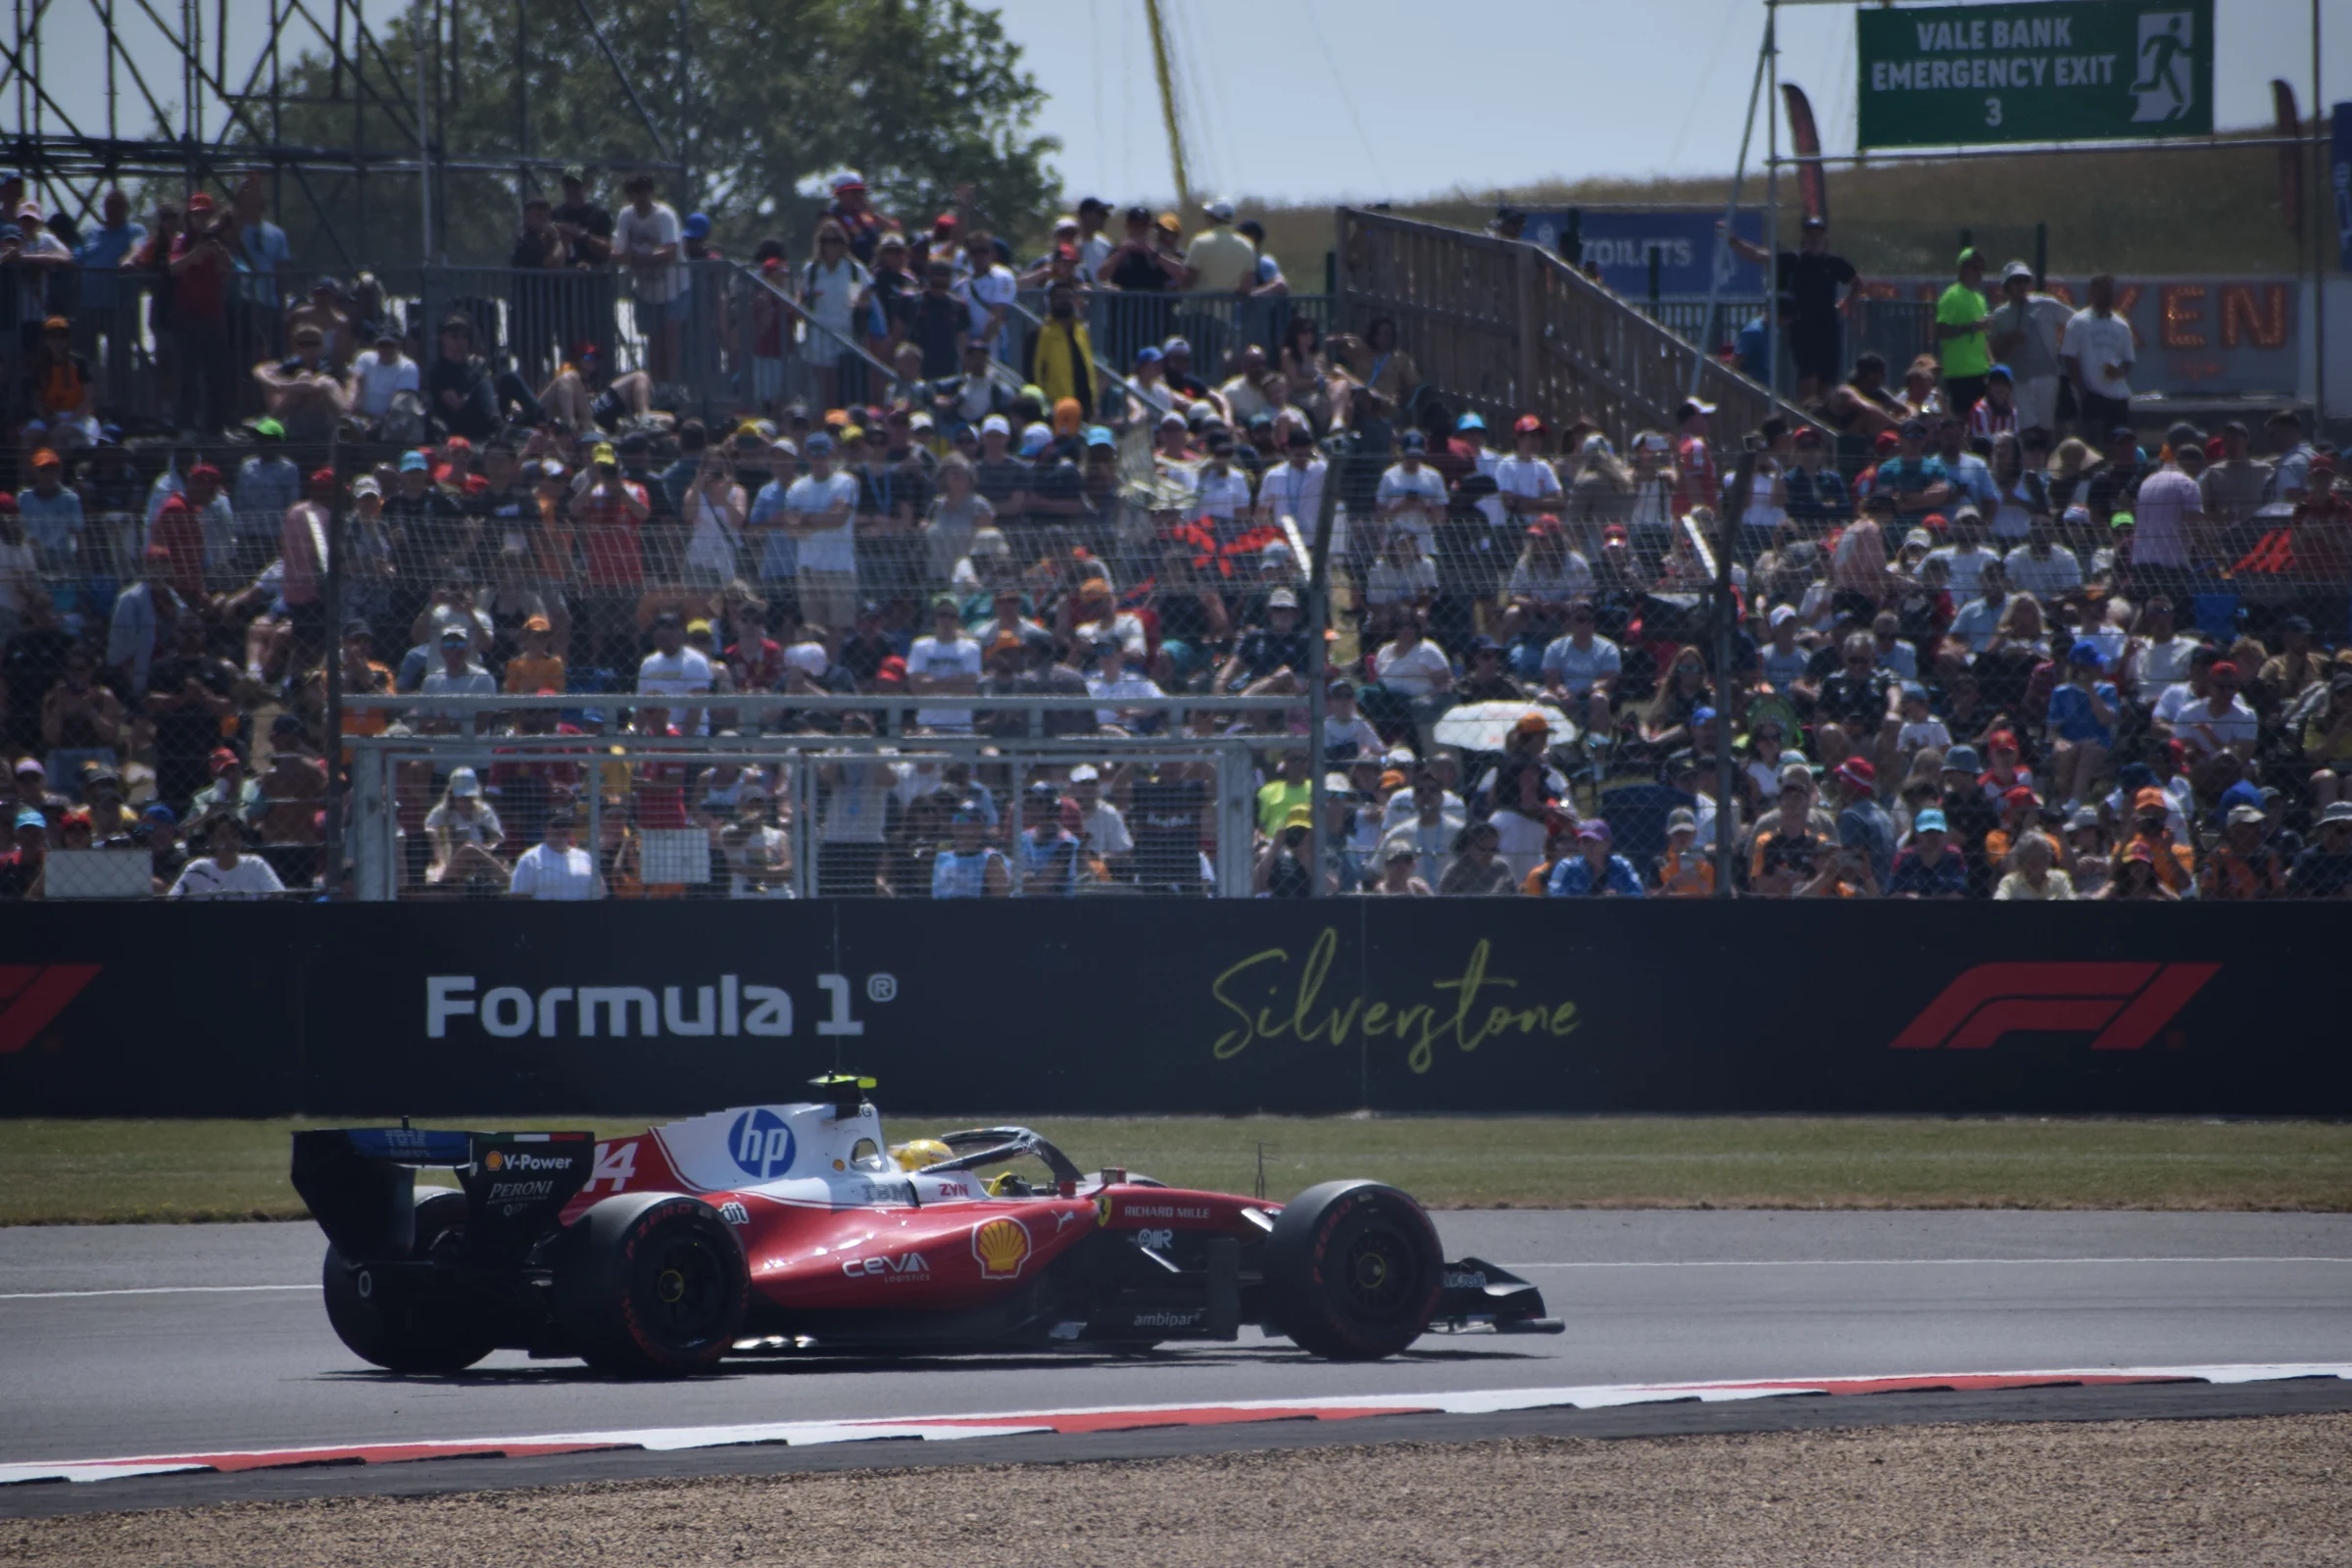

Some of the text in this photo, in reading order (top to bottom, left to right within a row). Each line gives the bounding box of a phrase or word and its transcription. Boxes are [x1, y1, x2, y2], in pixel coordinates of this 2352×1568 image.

[1917, 17, 2073, 51] VALE BANK
[1872, 54, 2117, 91] EMERGENCY EXIT
[1984, 97, 2003, 126] 3
[425, 973, 792, 1038] Formula
[1212, 926, 1580, 1075] Silverstone
[1888, 961, 2223, 1050] F1
[503, 1153, 573, 1171] V-Power
[739, 1114, 787, 1178] hp
[488, 1180, 554, 1200] PERONI
[860, 1183, 911, 1201] IBM
[1124, 1205, 1211, 1219] RICHARD MILLE
